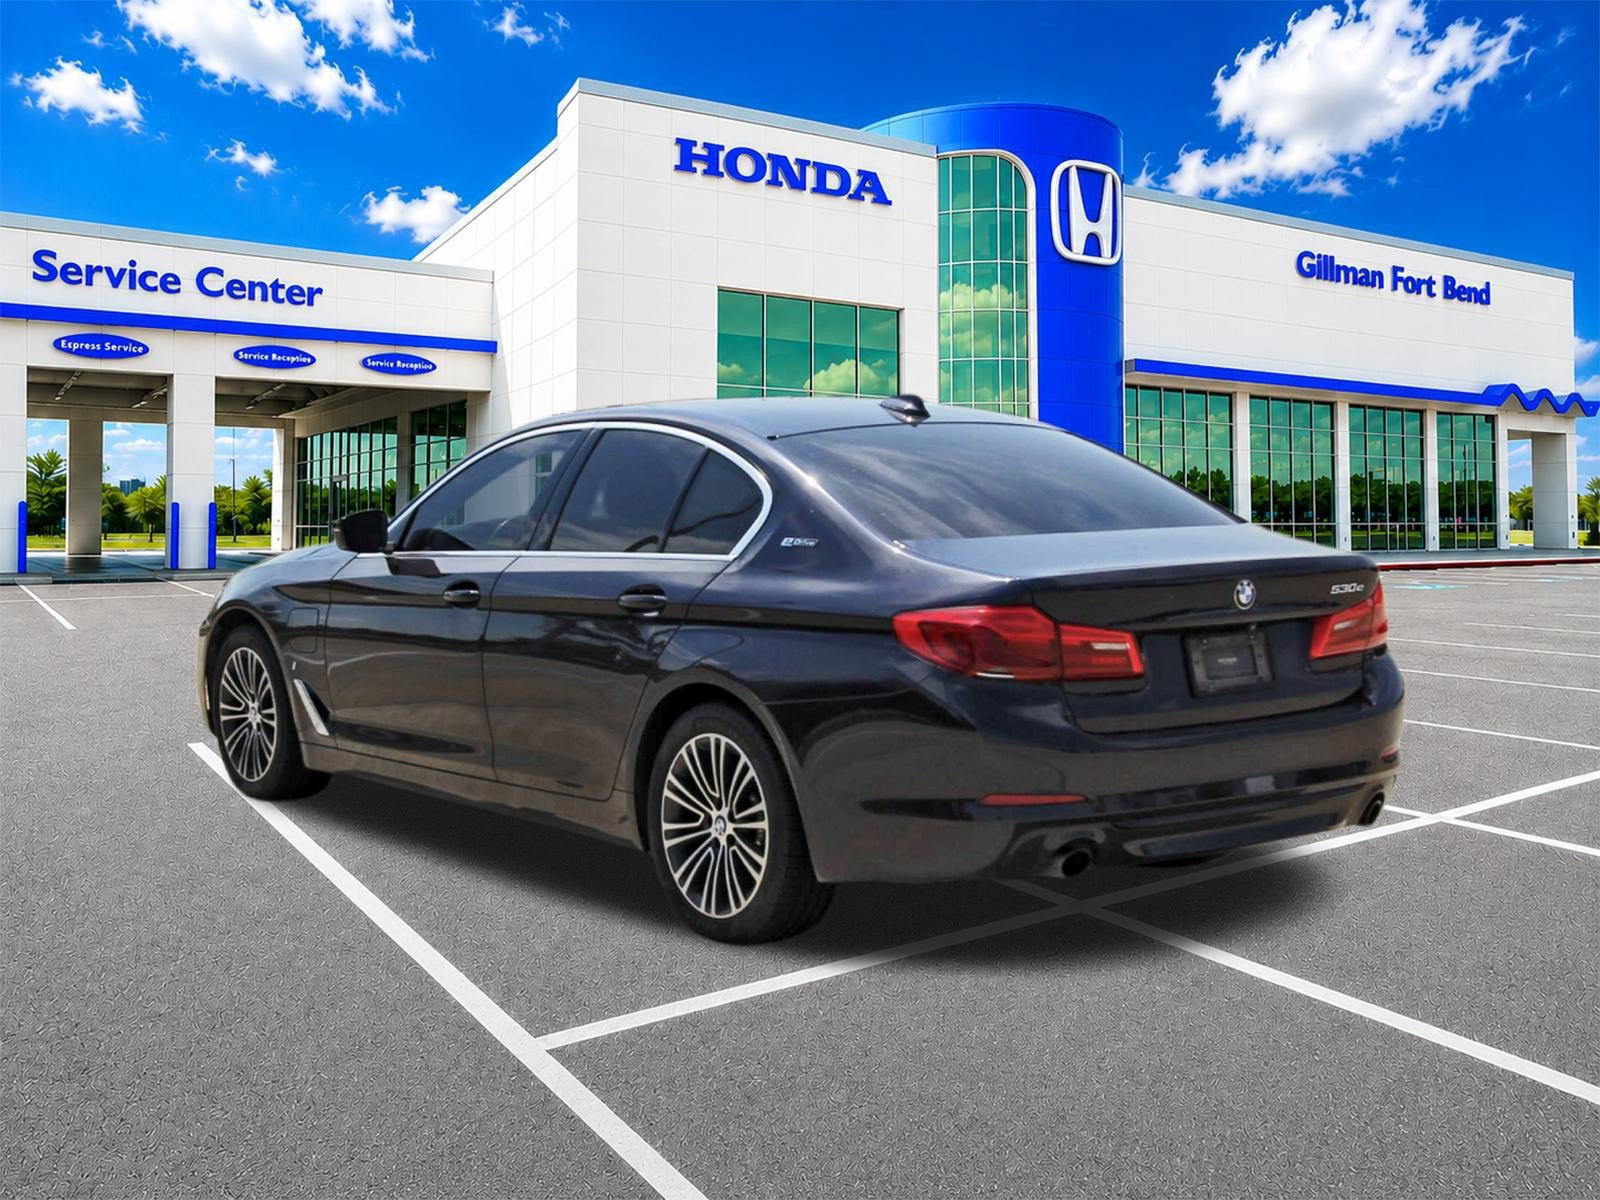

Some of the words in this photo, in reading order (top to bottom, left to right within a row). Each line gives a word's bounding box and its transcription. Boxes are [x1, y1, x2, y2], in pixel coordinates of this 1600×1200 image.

[674, 137, 892, 206] HONDA
[32, 249, 181, 294] Service
[195, 266, 324, 307] Center
[1296, 251, 1384, 289] Gillman
[1391, 265, 1437, 298] Fort
[1442, 275, 1491, 305] Bend
[104, 342, 144, 353] Service
[238, 351, 270, 361] Service
[366, 358, 395, 368] Service
[1330, 583, 1365, 594] 530e
